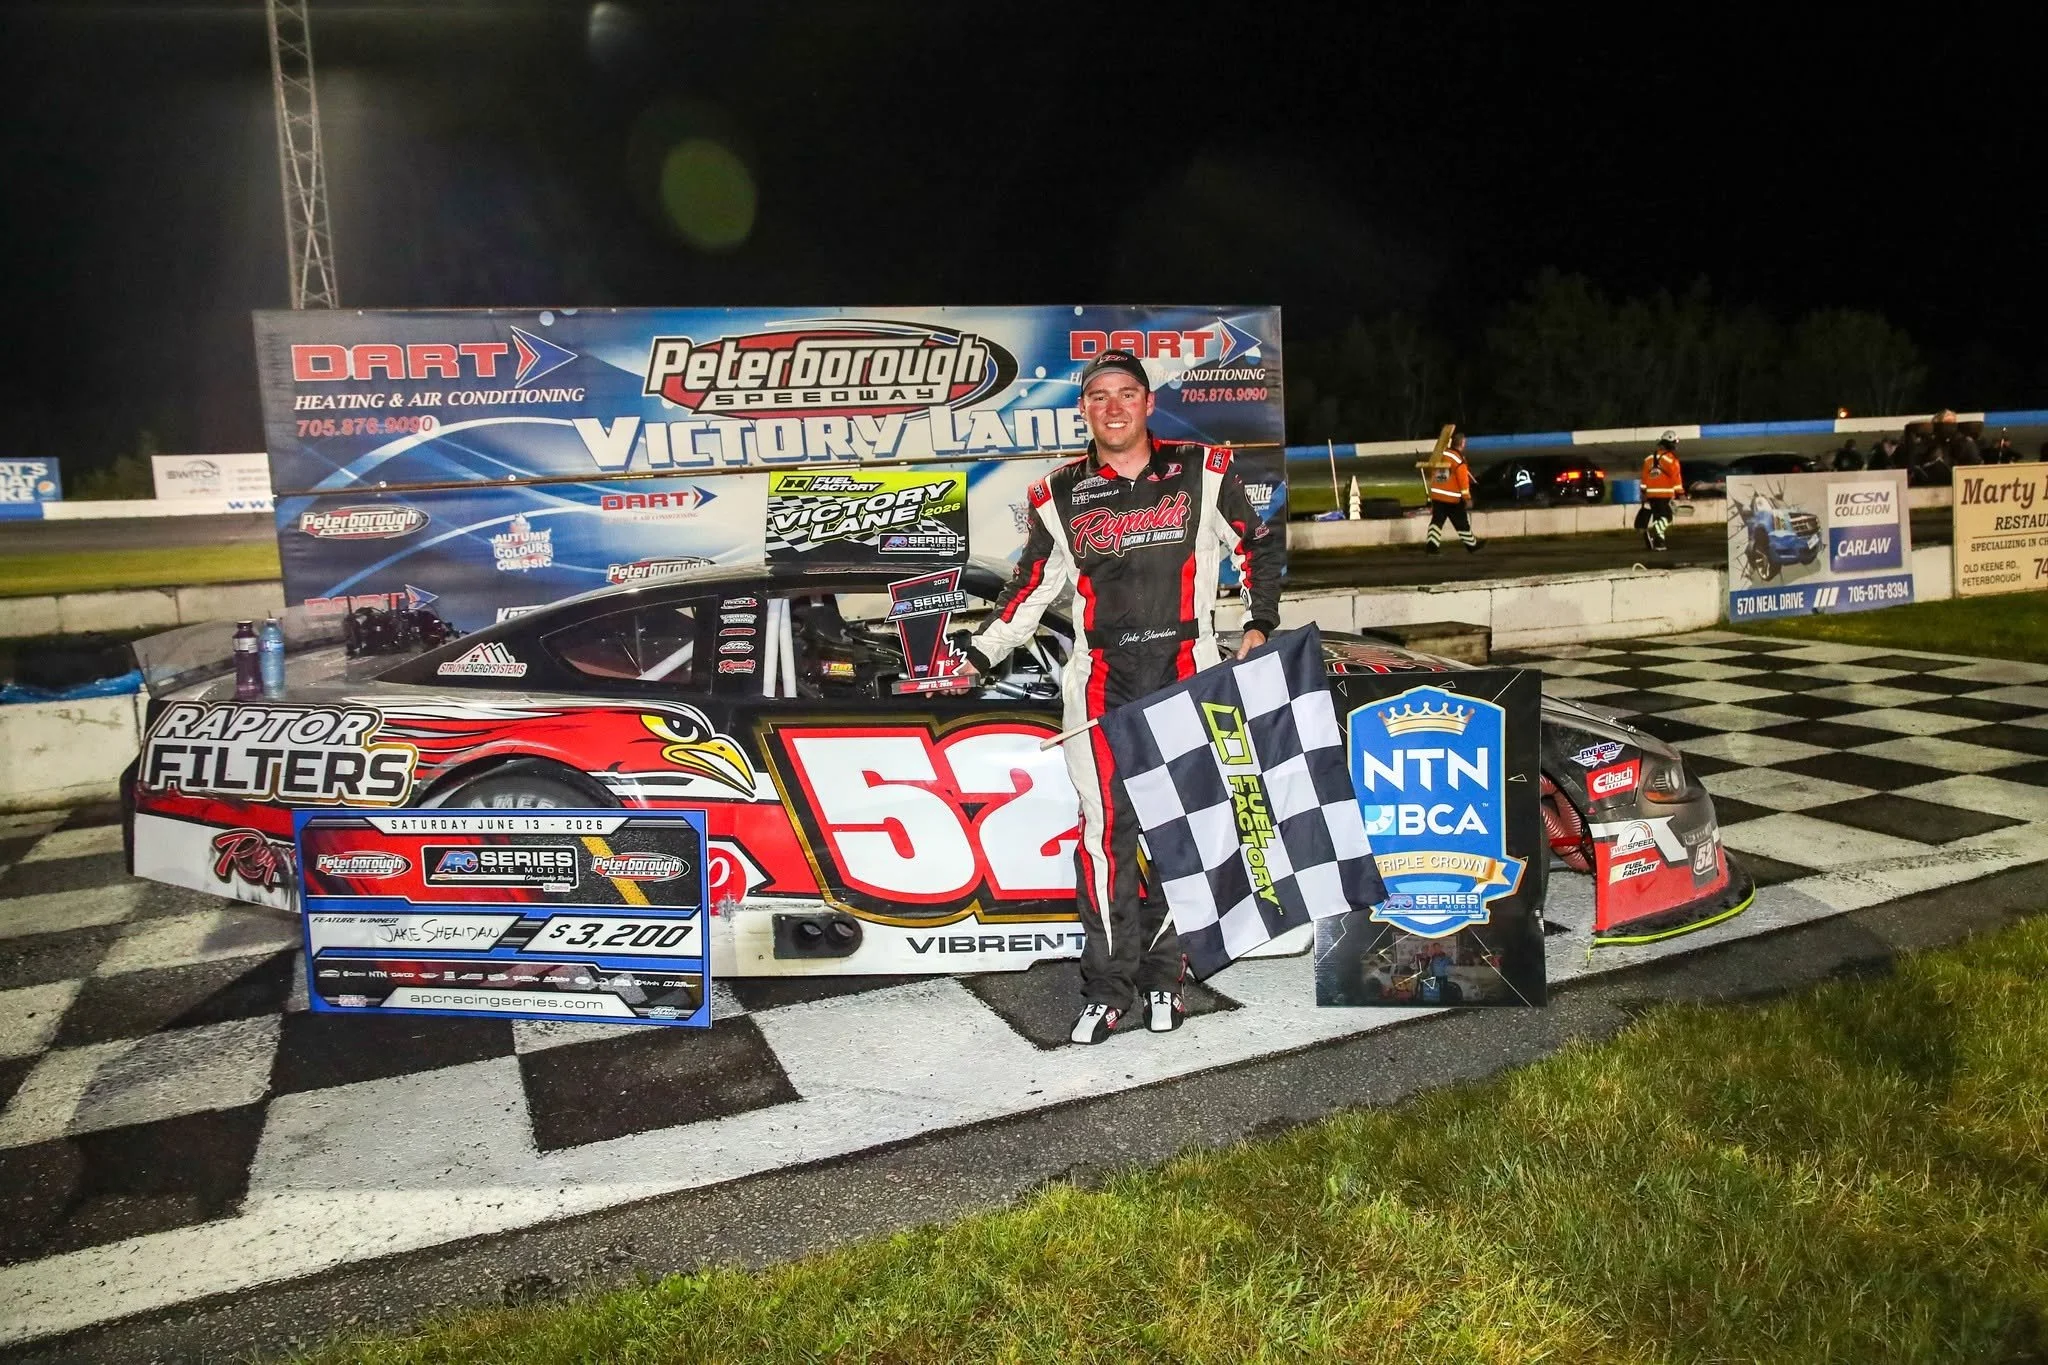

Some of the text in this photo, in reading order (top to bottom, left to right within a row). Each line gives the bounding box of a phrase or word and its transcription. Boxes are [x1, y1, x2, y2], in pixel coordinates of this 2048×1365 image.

[1070, 331, 1215, 361] DART
[291, 343, 508, 381] DART
[651, 334, 986, 397] Peterborough
[1174, 368, 1265, 382] CONDITIONING
[294, 388, 585, 410] HEATING & AIR CONDITIONING
[715, 389, 935, 405] SPEEDWAY
[1181, 388, 1268, 403] 705.876.9090
[296, 416, 432, 437] 705.876.9090
[572, 406, 1092, 470] VICTORY LANE
[810, 483, 881, 491] FACTORY
[1961, 477, 2035, 509] Marty
[602, 492, 689, 511] DART
[774, 481, 955, 530] VICTORY
[1850, 492, 1890, 503] CSN
[924, 503, 961, 517] 2026
[1835, 505, 1890, 517] COLLISION
[302, 510, 417, 529] Peterborough
[811, 505, 918, 540] LANE
[1070, 493, 1187, 552] Reynolds
[1995, 513, 2048, 530] RESTAU
[494, 529, 550, 543] AUTUMN
[908, 536, 956, 544] SERIES
[1121, 530, 1184, 547] TRUCKING & HARVESTING
[496, 544, 552, 559] COLOURS
[1837, 537, 1891, 557] CARLAW
[1971, 540, 2026, 552] SPECIALIZING
[497, 558, 551, 571] CLASSIC
[1964, 564, 1978, 573] OLD
[1981, 562, 2003, 571] KEENE
[933, 578, 950, 586] 2026
[1962, 573, 2021, 586] PETERBOROUGH
[913, 592, 964, 608] SERIES
[1737, 581, 1908, 615] 570 NEAL DRIVE 705-876-8394
[1119, 628, 1176, 646] Jake Sheridan
[155, 707, 374, 745] RAPTOR
[151, 744, 409, 796] FILTERS
[1364, 747, 1489, 791] NTN
[1593, 766, 1632, 790] Eibach
[780, 726, 1080, 900] 52
[1243, 775, 1276, 848] FUEL
[1399, 804, 1489, 835] BCA
[392, 820, 467, 829] SATURDAY
[478, 820, 514, 829] JUNE
[526, 820, 539, 829] 13
[566, 820, 603, 829] 2026
[1228, 775, 1279, 907] FACTORY
[318, 855, 402, 870] Peterborough
[436, 851, 573, 872] APC SERIES
[594, 857, 679, 871] Peterborough
[1431, 856, 1486, 872] CROWN
[1696, 842, 1713, 870] 52
[1622, 864, 1656, 877] FACTORY
[1625, 861, 1643, 870] FUEL
[1416, 895, 1478, 904] SERIES
[379, 923, 421, 943] JAKE
[550, 923, 693, 948] $3,200
[906, 933, 1085, 954] VIBRENT
[410, 994, 603, 1009] apcracingseries.com
